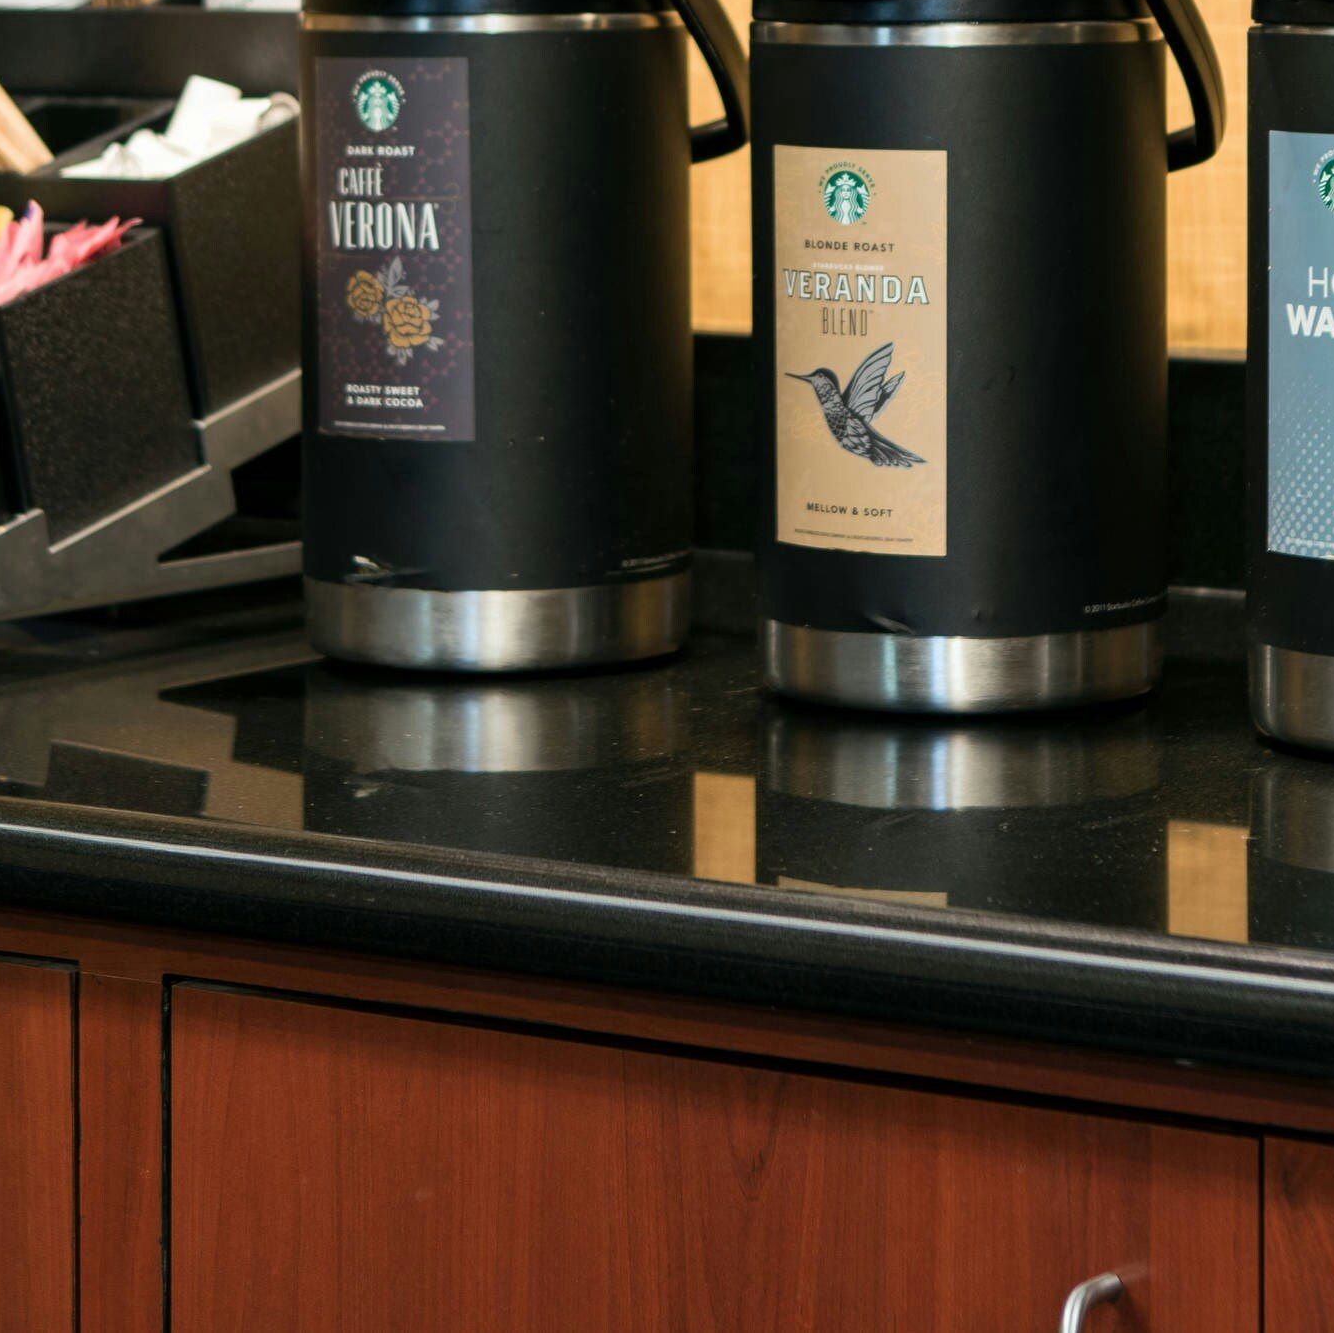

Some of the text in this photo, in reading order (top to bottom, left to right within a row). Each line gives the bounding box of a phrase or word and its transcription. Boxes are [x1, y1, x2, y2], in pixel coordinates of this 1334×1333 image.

[347, 145, 415, 157] DARK ROAST
[824, 161, 857, 174] PROUDLY
[339, 162, 384, 196] CAFFÈ
[329, 200, 440, 251] VERONA
[804, 238, 895, 252] BLONDE ROAST
[783, 268, 930, 305] VERANDA
[822, 306, 868, 337] BLEND
[345, 384, 420, 396] ROASTY SWEET
[355, 396, 382, 406] DARK
[385, 397, 424, 408] COCOA
[806, 502, 893, 517] MELLOW & SOFT
